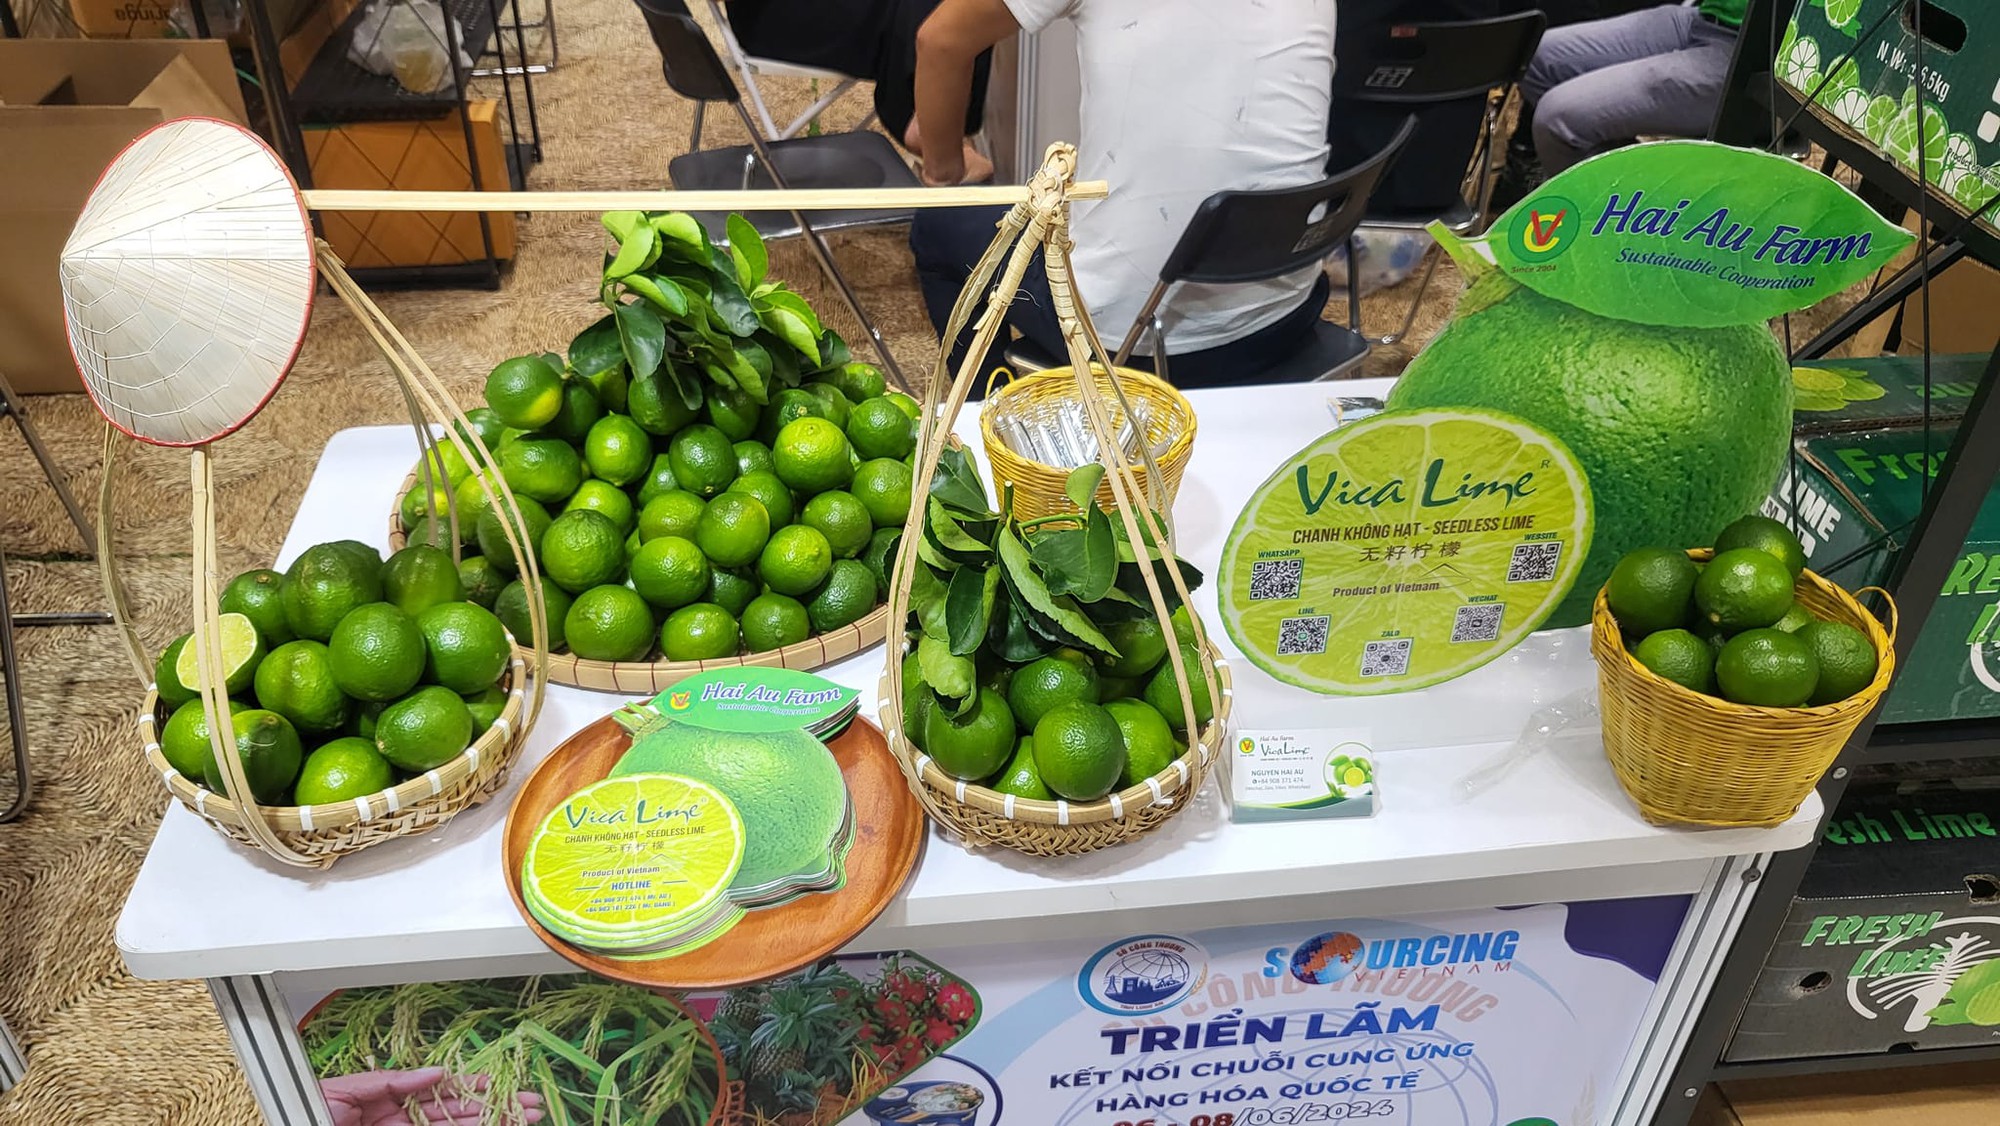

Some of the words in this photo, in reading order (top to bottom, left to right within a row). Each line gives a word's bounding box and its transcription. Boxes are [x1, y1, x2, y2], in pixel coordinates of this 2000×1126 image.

[1591, 190, 1690, 237] Hai
[1682, 208, 1753, 251] Au
[1754, 225, 1873, 266] Farm
[1511, 266, 1535, 274] Since
[1536, 264, 1557, 272] 2004
[1615, 247, 1717, 276] Sustainable
[1717, 265, 1816, 290] Cooperation
[1834, 447, 1949, 487] Fre
[1296, 464, 1406, 515] Vica
[1421, 458, 1537, 510] Lime
[1780, 470, 1841, 542] LIME
[1292, 529, 1341, 544] CHANH
[1343, 521, 1390, 541] KHÔNG
[1392, 522, 1421, 539] HẠT
[1432, 517, 1501, 535] SEEDLESS
[1502, 515, 1536, 530] LIME
[1524, 532, 1558, 540] WEBSITE
[1258, 549, 1300, 558] WHATSAPP
[1359, 541, 1461, 562] 无籽柠檬
[1333, 586, 1376, 597] Product
[1380, 585, 1391, 594] of
[1394, 582, 1440, 593] Vietnam
[1381, 630, 1400, 638] ZALO
[702, 682, 745, 701] Hai
[748, 684, 781, 702] Au
[784, 687, 841, 706] Farm
[566, 804, 628, 828] Vica
[637, 799, 701, 824] Lime
[1824, 812, 1891, 845] esh
[1891, 808, 1996, 841] Lime
[565, 835, 593, 843] CHANH
[594, 832, 622, 842] KHÔNG
[623, 831, 639, 840] HẠT
[646, 827, 685, 838] SEEDLESS
[687, 825, 706, 835] LIME
[627, 866, 660, 874] Vietnam
[612, 880, 651, 890] HOTLINE
[1801, 911, 1944, 947] FRESH
[1129, 942, 1152, 953] CÔNG
[1848, 946, 1951, 980] LIME
[1100, 1007, 1287, 1056] TRIỂN
[1305, 1000, 1441, 1040] LÃM
[1050, 1066, 1113, 1089] KẾT
[1122, 1060, 1180, 1083] NỐI
[1191, 1051, 1295, 1077] CHUỖI
[1305, 1048, 1396, 1069] CUNG
[1405, 1042, 1475, 1062] ỨNG
[1096, 1092, 1189, 1112] HÀNG
[1199, 1083, 1268, 1105] HÓA
[1279, 1075, 1370, 1101] QUỐC
[1382, 1068, 1424, 1090] TẾ
